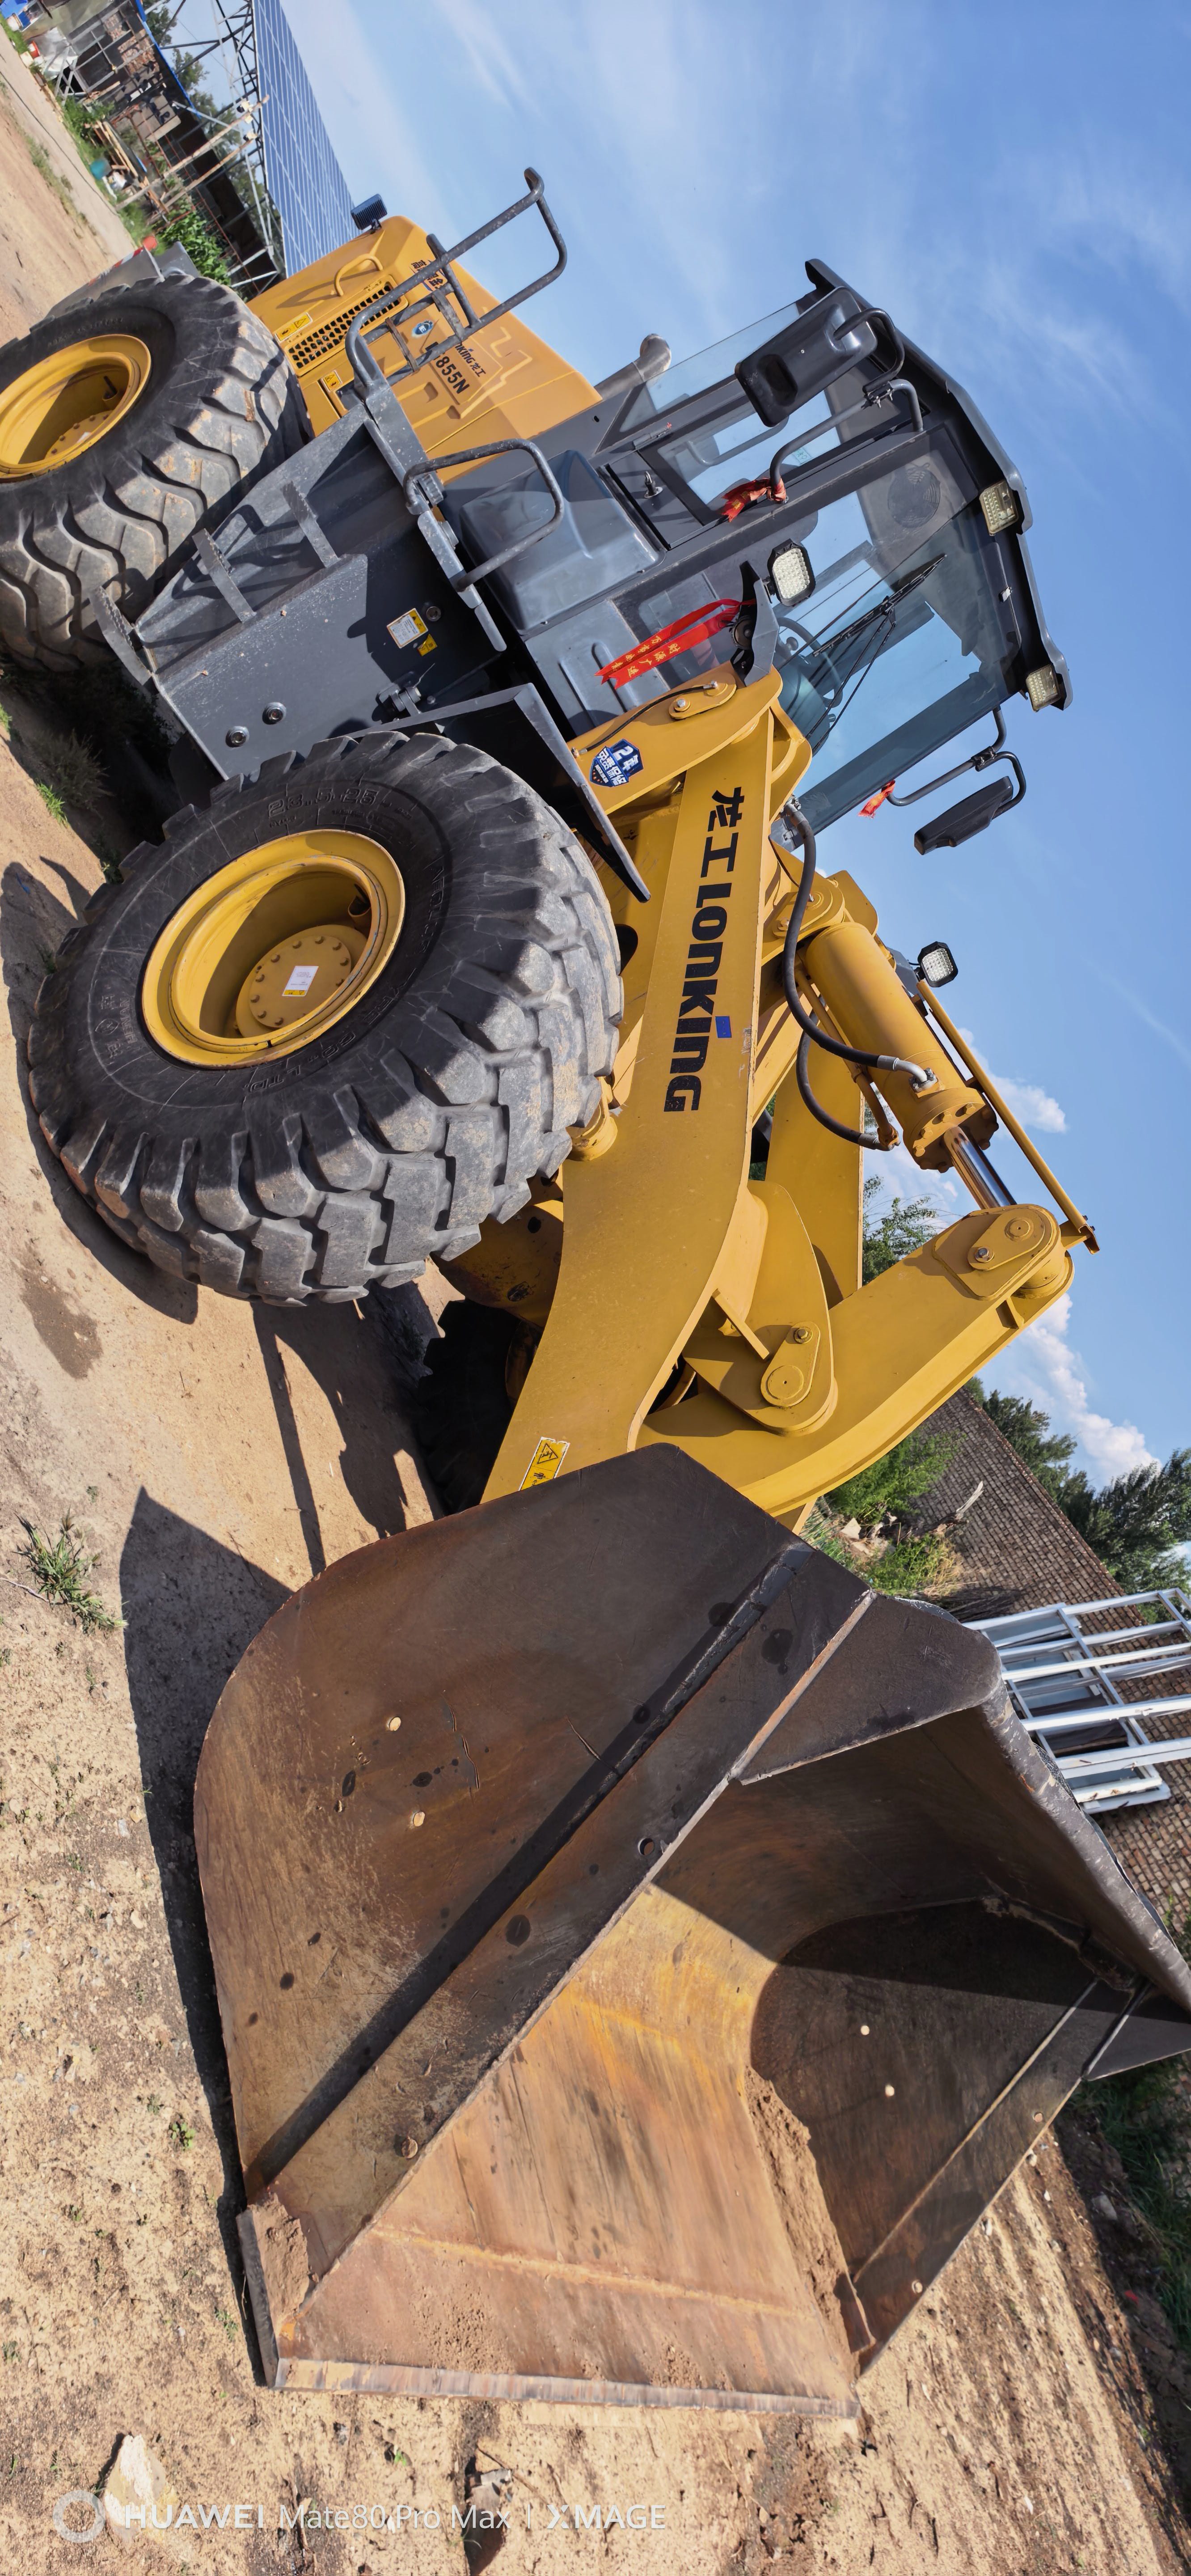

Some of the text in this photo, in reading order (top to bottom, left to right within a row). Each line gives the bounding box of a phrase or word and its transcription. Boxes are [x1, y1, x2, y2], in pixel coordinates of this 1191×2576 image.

[425, 342, 470, 394] 855N
[455, 342, 486, 377] NKING 龙工
[627, 643, 681, 677] 财源广进
[597, 747, 627, 786] 免费保修
[612, 746, 639, 771] 2年
[701, 787, 744, 878] 龙工
